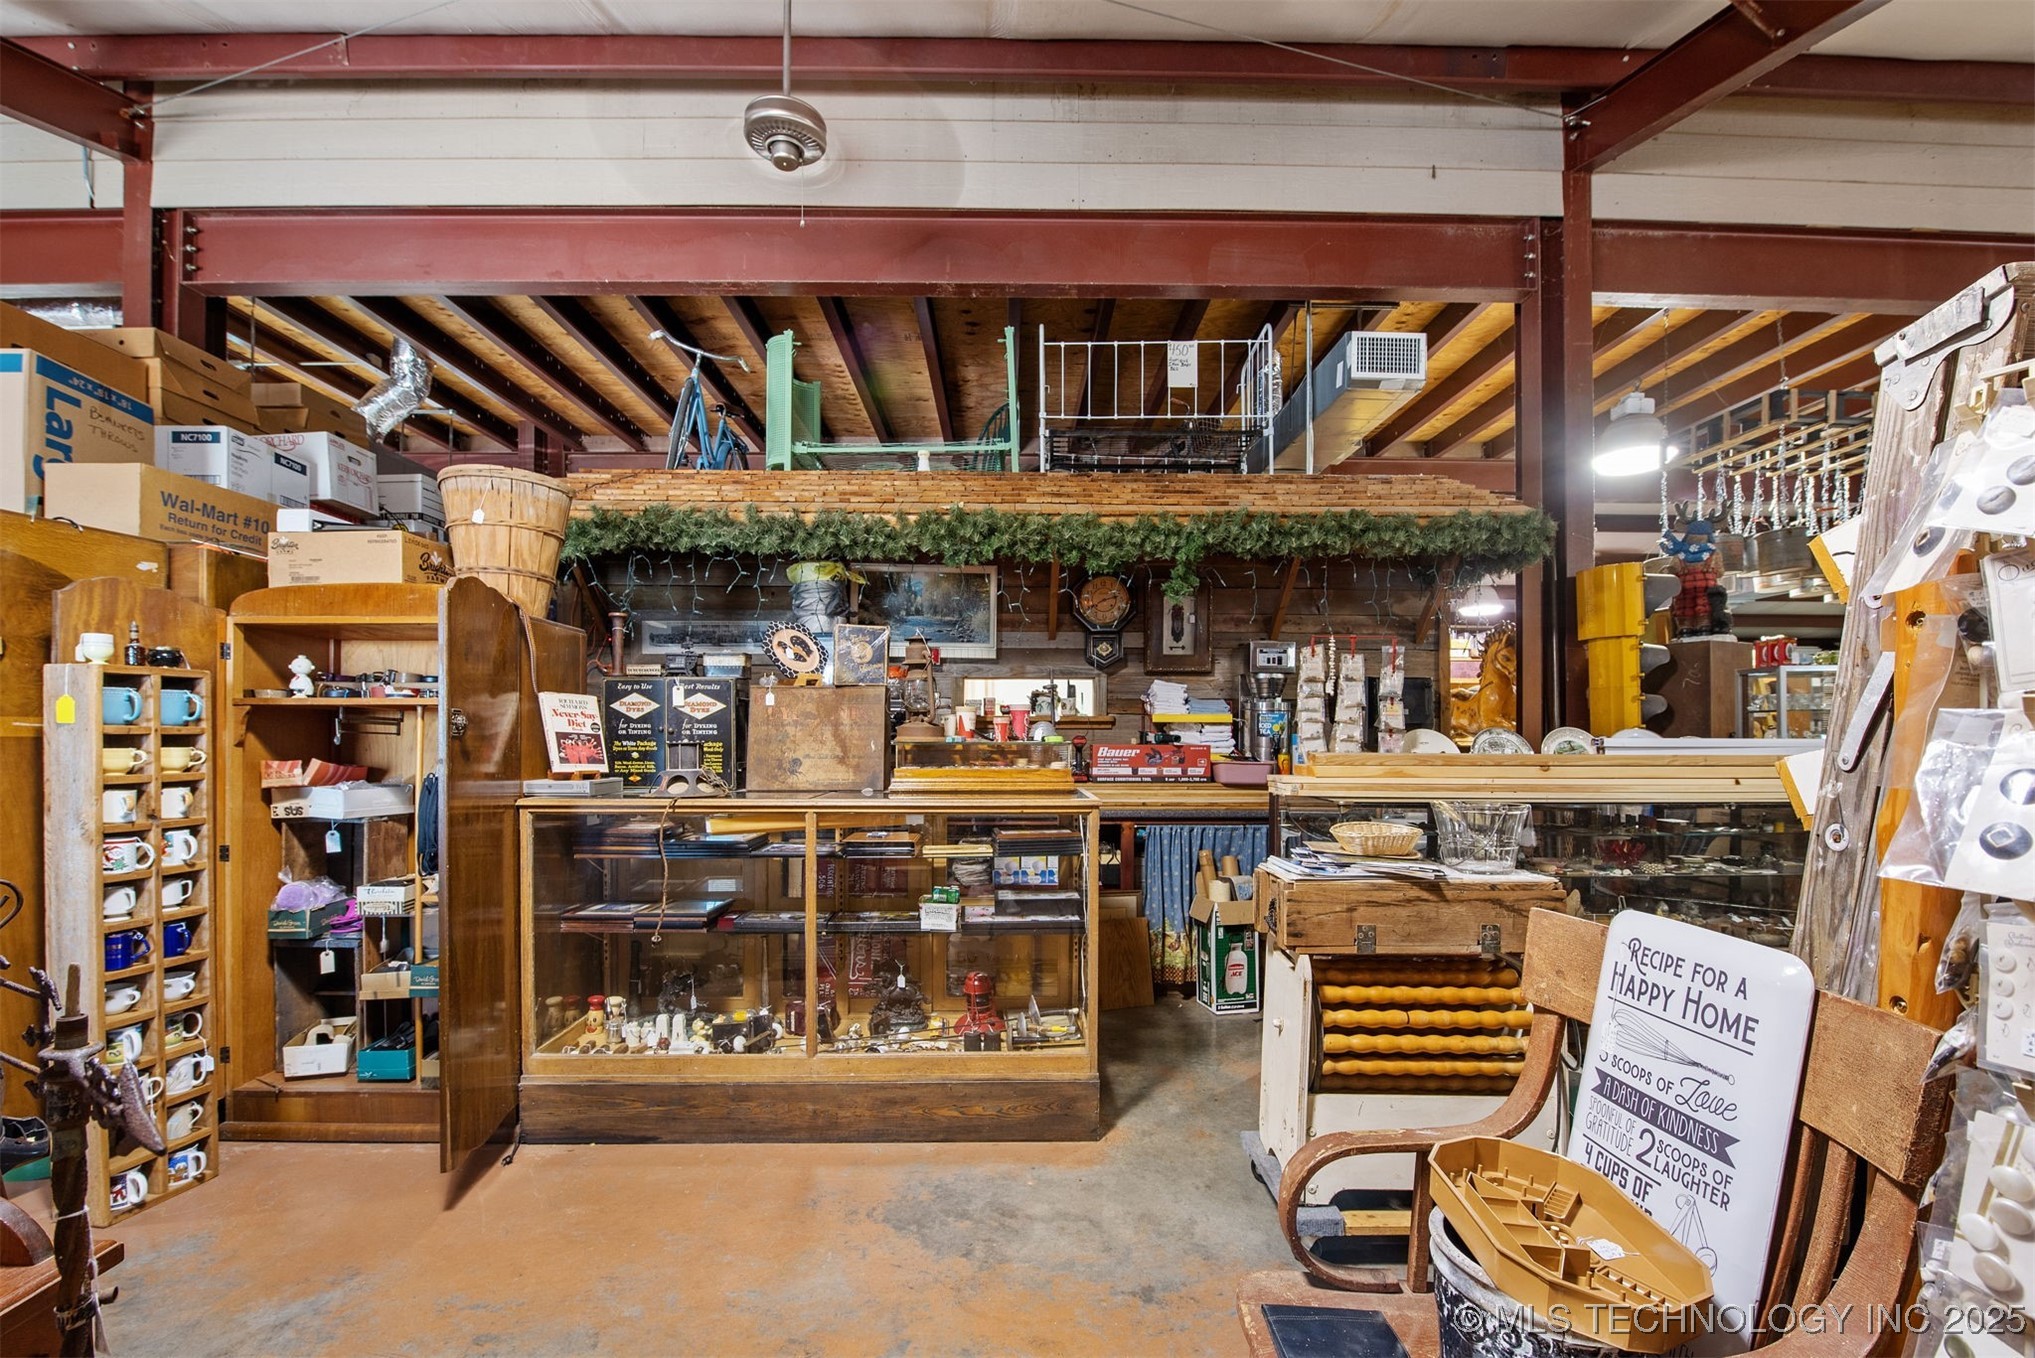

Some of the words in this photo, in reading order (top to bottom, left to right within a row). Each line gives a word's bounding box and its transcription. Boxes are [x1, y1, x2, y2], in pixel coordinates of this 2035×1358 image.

[180, 433, 213, 442] NC7100
[160, 490, 239, 526] Wal-Mart
[244, 516, 270, 534] #10
[168, 512, 208, 532] Return
[212, 524, 227, 536] for
[230, 529, 262, 546] Credit
[618, 683, 632, 691] Easy
[568, 718, 586, 728] Diet
[619, 718, 628, 730] for
[682, 718, 692, 730] for
[1097, 746, 1140, 758] Bauer
[1627, 937, 1686, 978] RECIPE
[1690, 962, 1728, 993] FOR
[1734, 977, 1748, 1000] A
[1610, 961, 1676, 1012] HAPPY
[1682, 986, 1760, 1046] HOME
[1612, 1054, 1652, 1086] SCOOPS
[1656, 1077, 1674, 1095] OF
[1675, 1076, 1738, 1122] Love
[1586, 1112, 1634, 1158] GRATITUDE
[1589, 1095, 1622, 1128] SPOONFUL
[1625, 1118, 1636, 1135] OF
[1603, 1076, 1612, 1096] A
[1612, 1080, 1639, 1112] DASH
[1640, 1097, 1657, 1120] OF
[1658, 1105, 1720, 1154] KINDNESS
[1585, 1142, 1594, 1165] 4
[1594, 1150, 1630, 1190] CUPS
[1632, 1175, 1654, 1203] OF
[1636, 1128, 1656, 1168] 2
[1656, 1139, 1708, 1178] SCOOPS
[1712, 1170, 1734, 1190] OF
[1653, 1154, 1731, 1212] LAUGHTER
